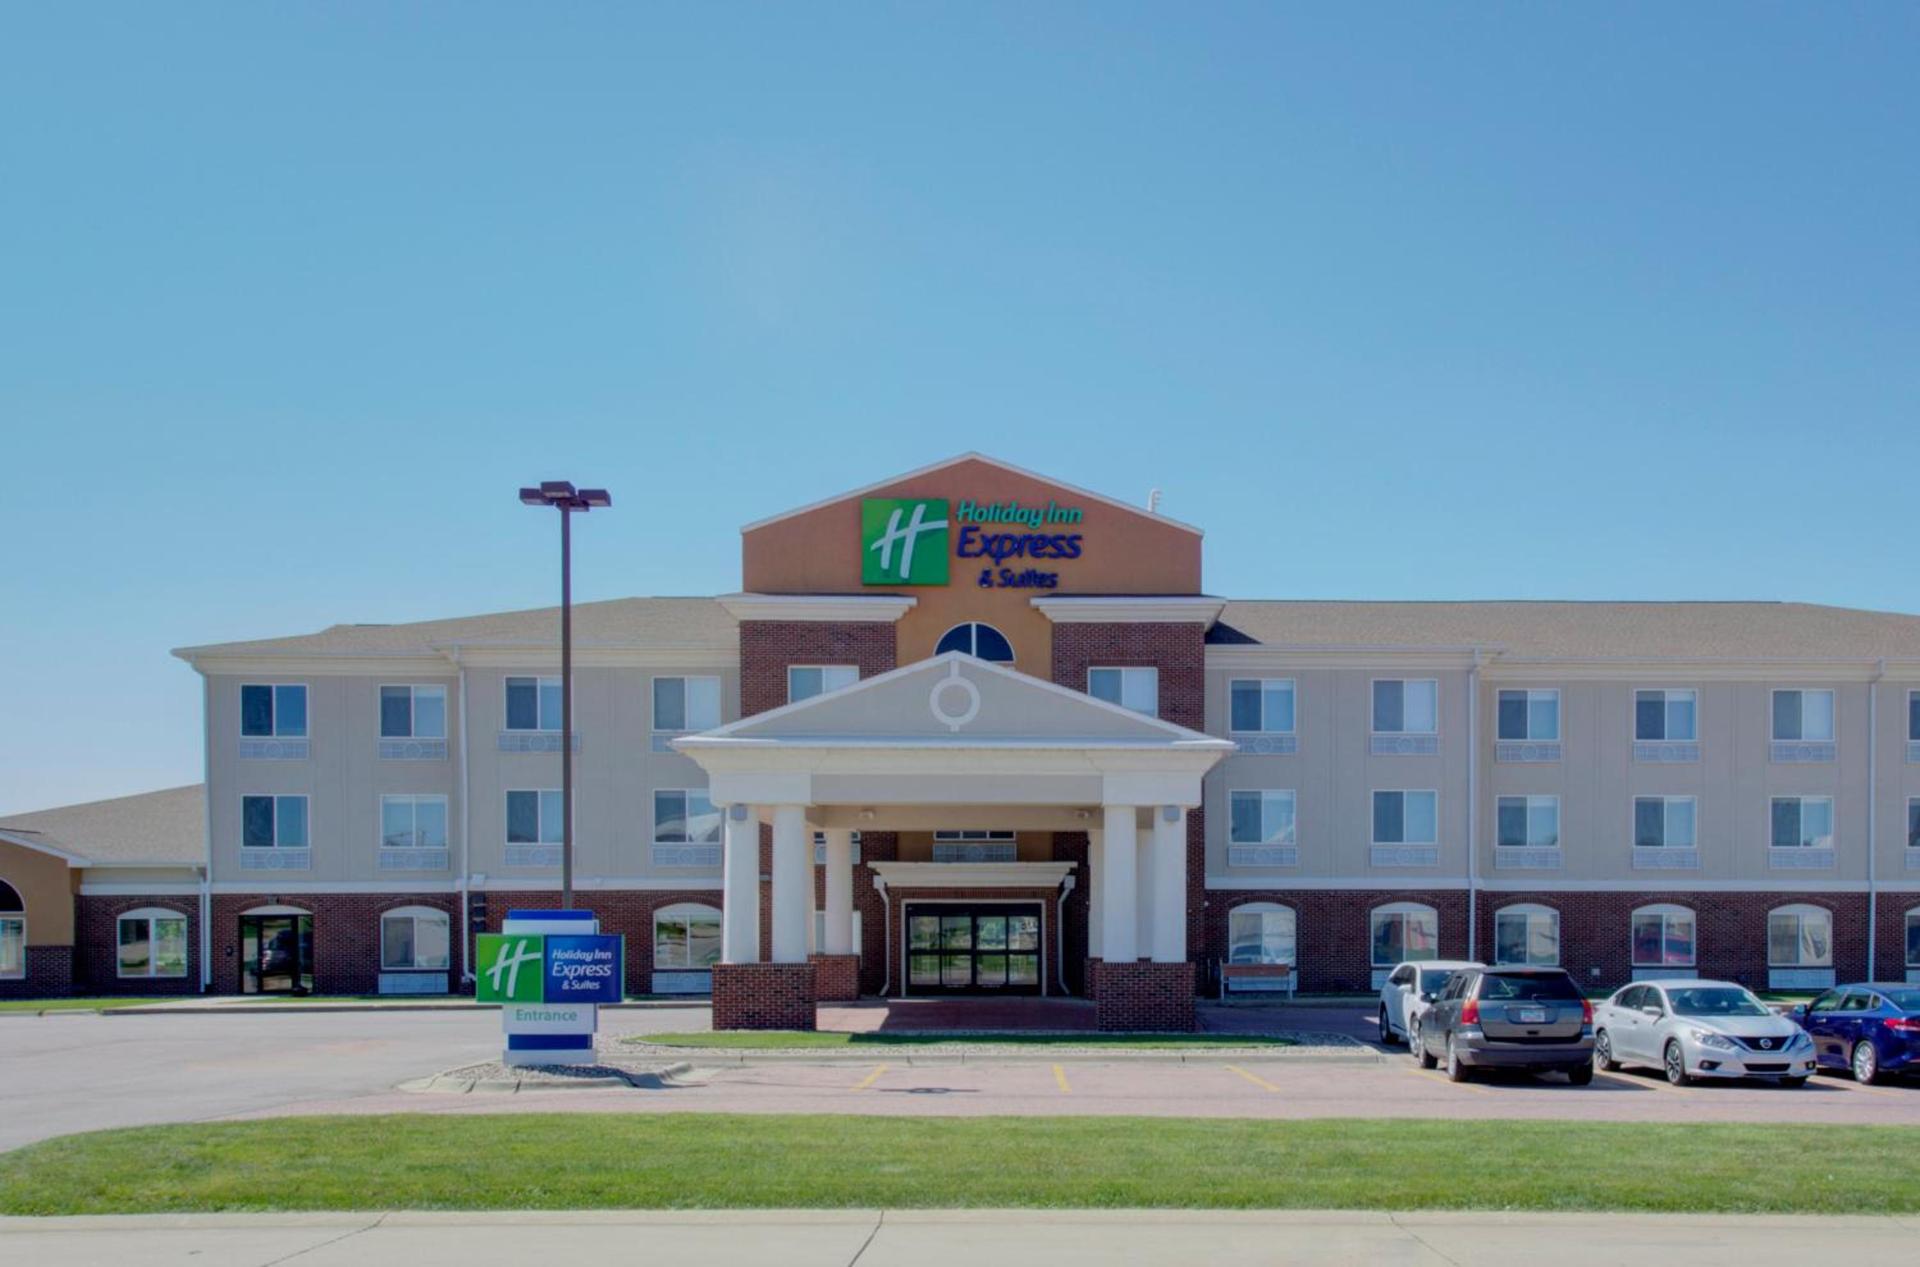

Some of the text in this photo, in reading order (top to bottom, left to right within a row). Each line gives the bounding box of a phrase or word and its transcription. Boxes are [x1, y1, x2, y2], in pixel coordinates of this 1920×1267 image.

[957, 500, 1082, 528] Holiday Inn
[957, 526, 1082, 565] Express
[978, 568, 1059, 589] & Suites
[552, 949, 612, 962] Holiday Inn
[552, 962, 611, 979] Express
[562, 980, 600, 990] & Suites
[516, 1009, 577, 1021] Entrance
